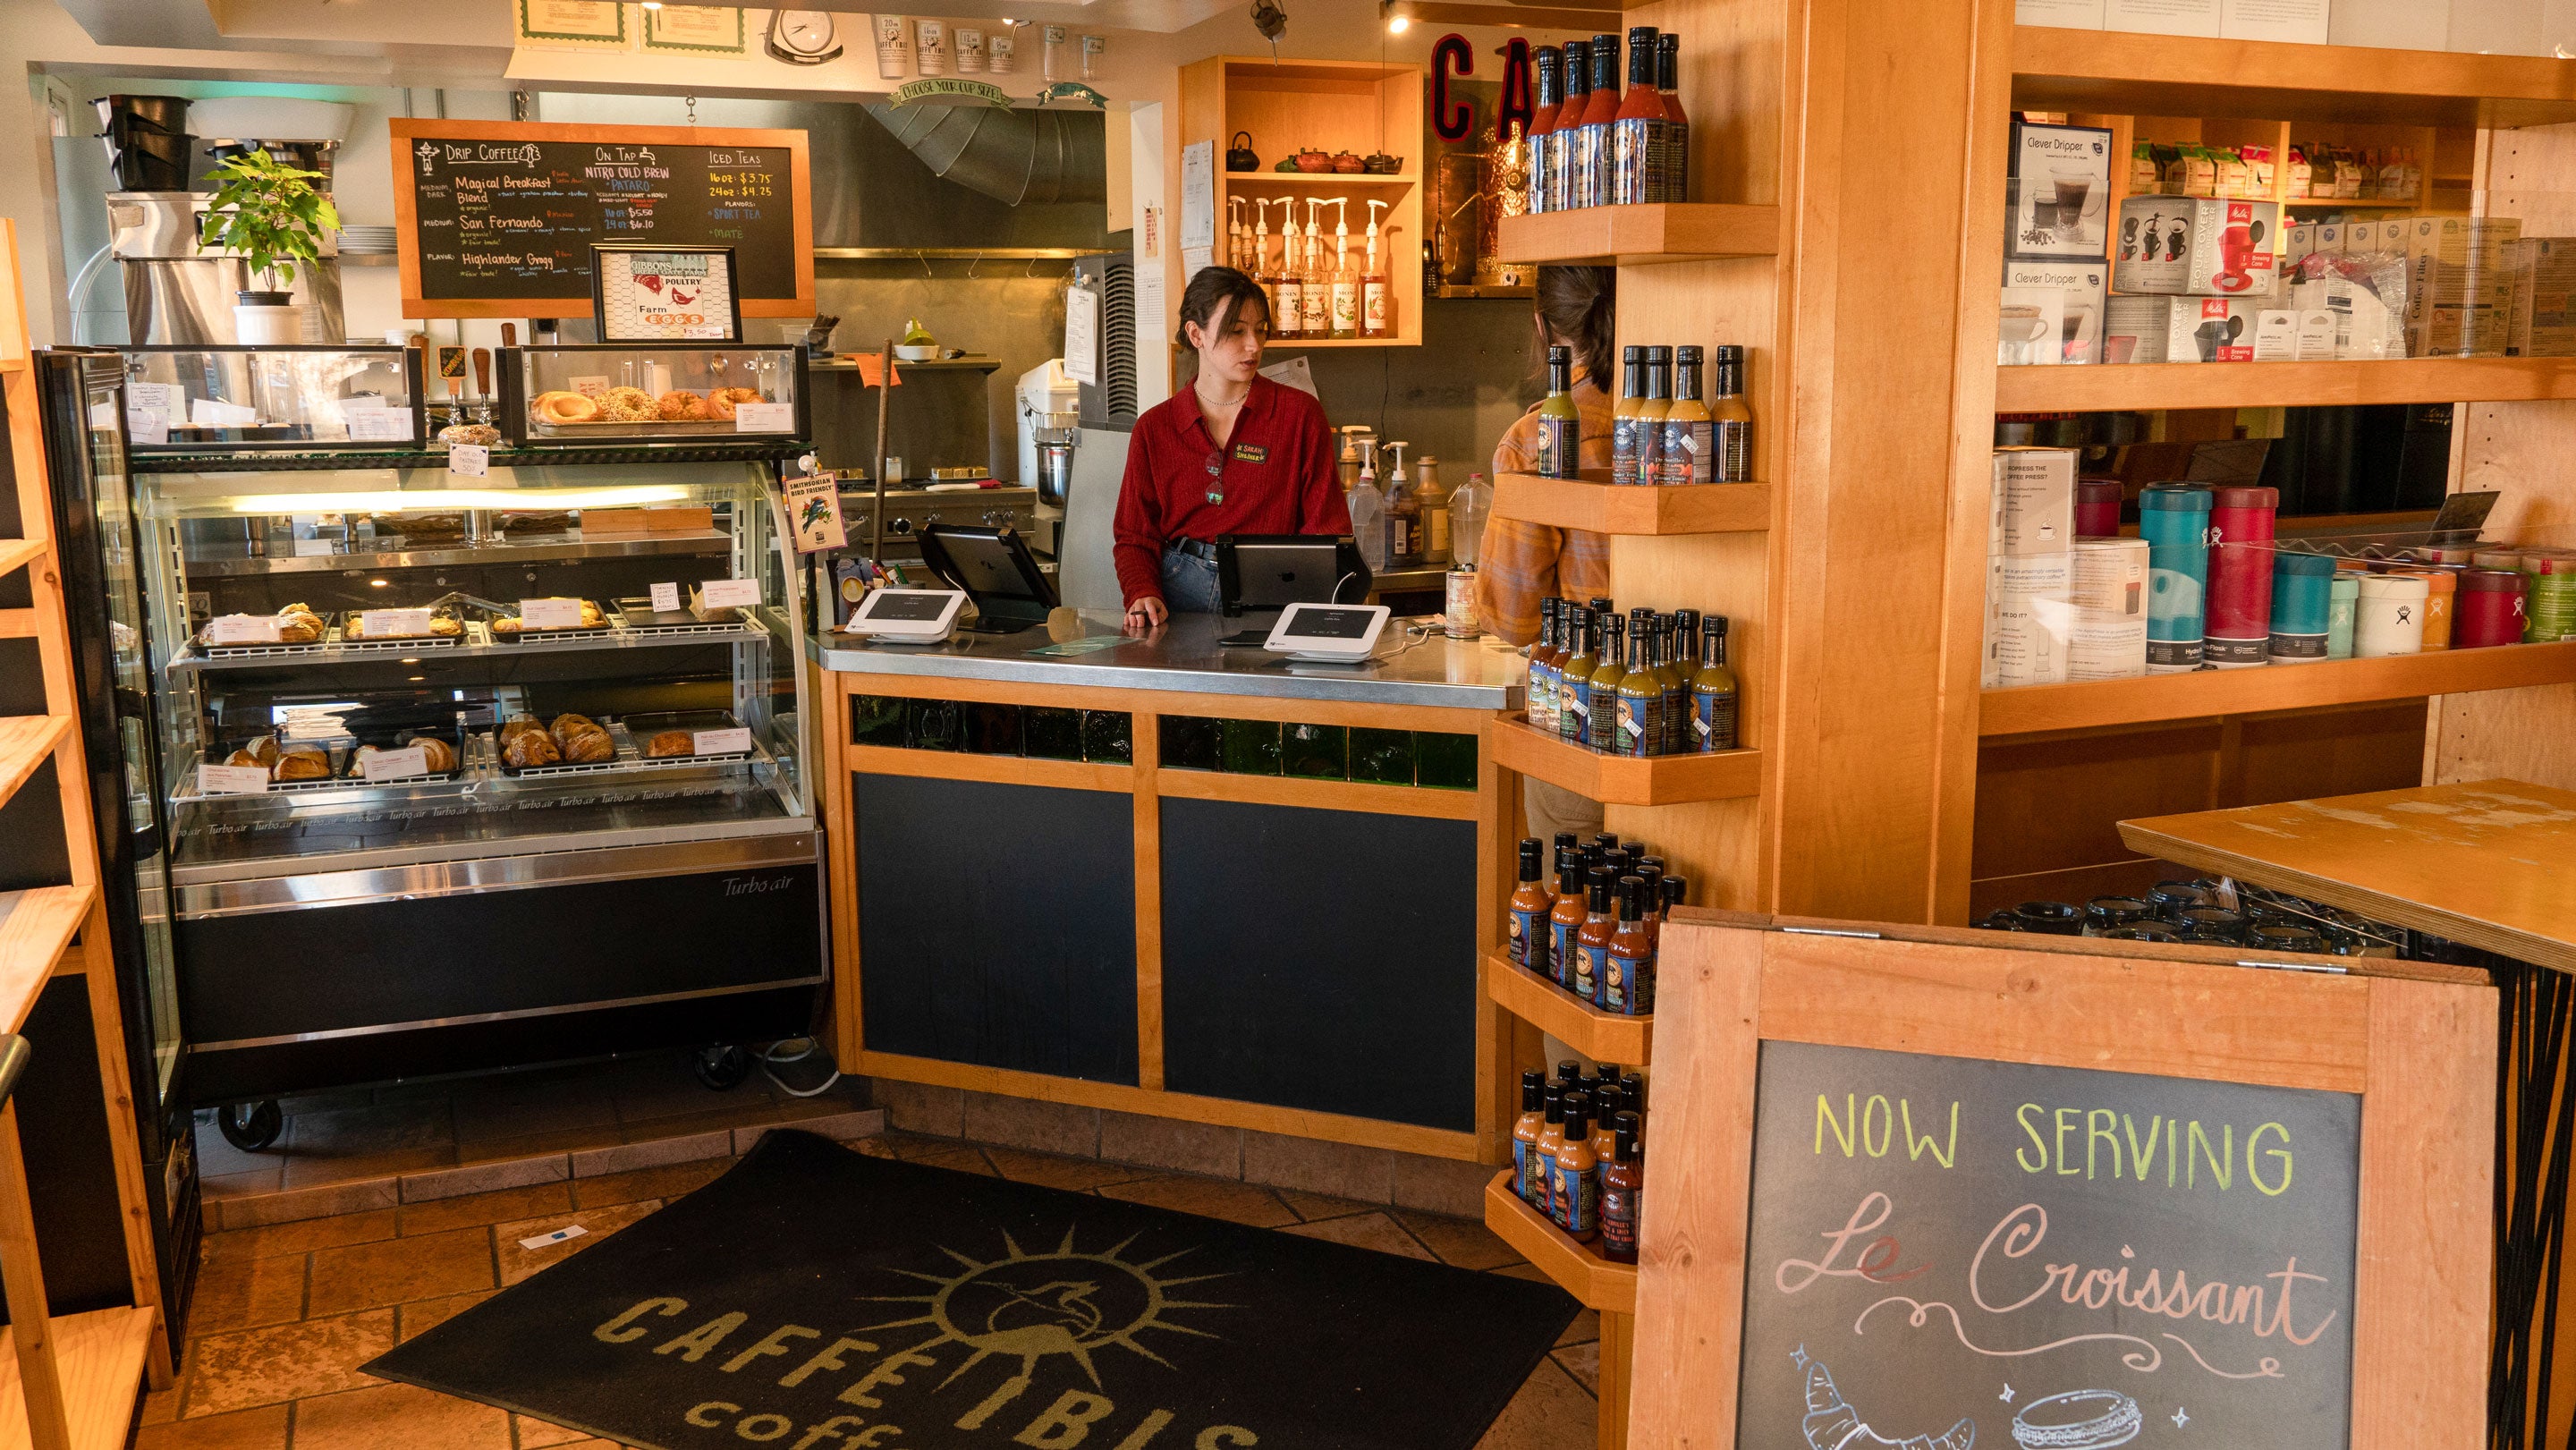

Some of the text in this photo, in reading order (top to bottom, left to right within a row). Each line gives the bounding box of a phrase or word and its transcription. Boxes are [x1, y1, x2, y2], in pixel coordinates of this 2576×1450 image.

[902, 81, 1000, 100] CHOOSE YOUR CUP SIZE!
[2027, 137, 2083, 153] Clever Dripper
[445, 144, 518, 161] DRIP COFFEE
[709, 150, 761, 164] ICED TEAS
[585, 166, 669, 179] NITRO COLD BREW
[740, 173, 773, 184] $3.75
[455, 175, 551, 193] Magical Breakfast
[612, 180, 650, 192] PATARO
[458, 192, 488, 204] Blend
[742, 187, 772, 197] $4.25
[628, 207, 653, 218] $5.50
[714, 209, 761, 220] SPORT TEA
[459, 215, 543, 229] San Fernando
[630, 220, 654, 230] $6.10
[462, 253, 553, 270] Highlander Grogg
[631, 261, 671, 270] GIBBONS
[2015, 273, 2077, 286] Clever Dripper
[2412, 247, 2428, 319] Coffee Filters
[640, 305, 667, 313] Farm
[648, 315, 700, 325] EGGS
[684, 328, 707, 337] $3.50
[1243, 445, 1263, 454] SARAH
[790, 478, 831, 489] SMITHSONIAN
[806, 486, 832, 494] FRIENDLY
[208, 824, 233, 835] Turbo
[234, 824, 247, 833] air
[253, 821, 279, 831] Turbo
[280, 821, 292, 829] air
[389, 810, 412, 820] Turbo
[413, 810, 426, 819] air
[432, 807, 455, 817] Turbo
[456, 807, 469, 815] air
[476, 804, 499, 814] Turbo
[518, 801, 541, 811] Turbo
[541, 800, 554, 809] air
[560, 797, 582, 807] Turbo
[583, 796, 595, 805] air
[601, 793, 624, 804] Turbo
[624, 793, 636, 801] air
[642, 790, 664, 800] Turbo
[665, 790, 677, 798] air
[682, 787, 704, 797] Turbo
[722, 874, 794, 897] Turbo air
[1814, 1093, 2293, 1197] NOW SERVING
[1776, 1191, 2337, 1346] Le Croissant
[591, 1294, 938, 1410] CAFFE
